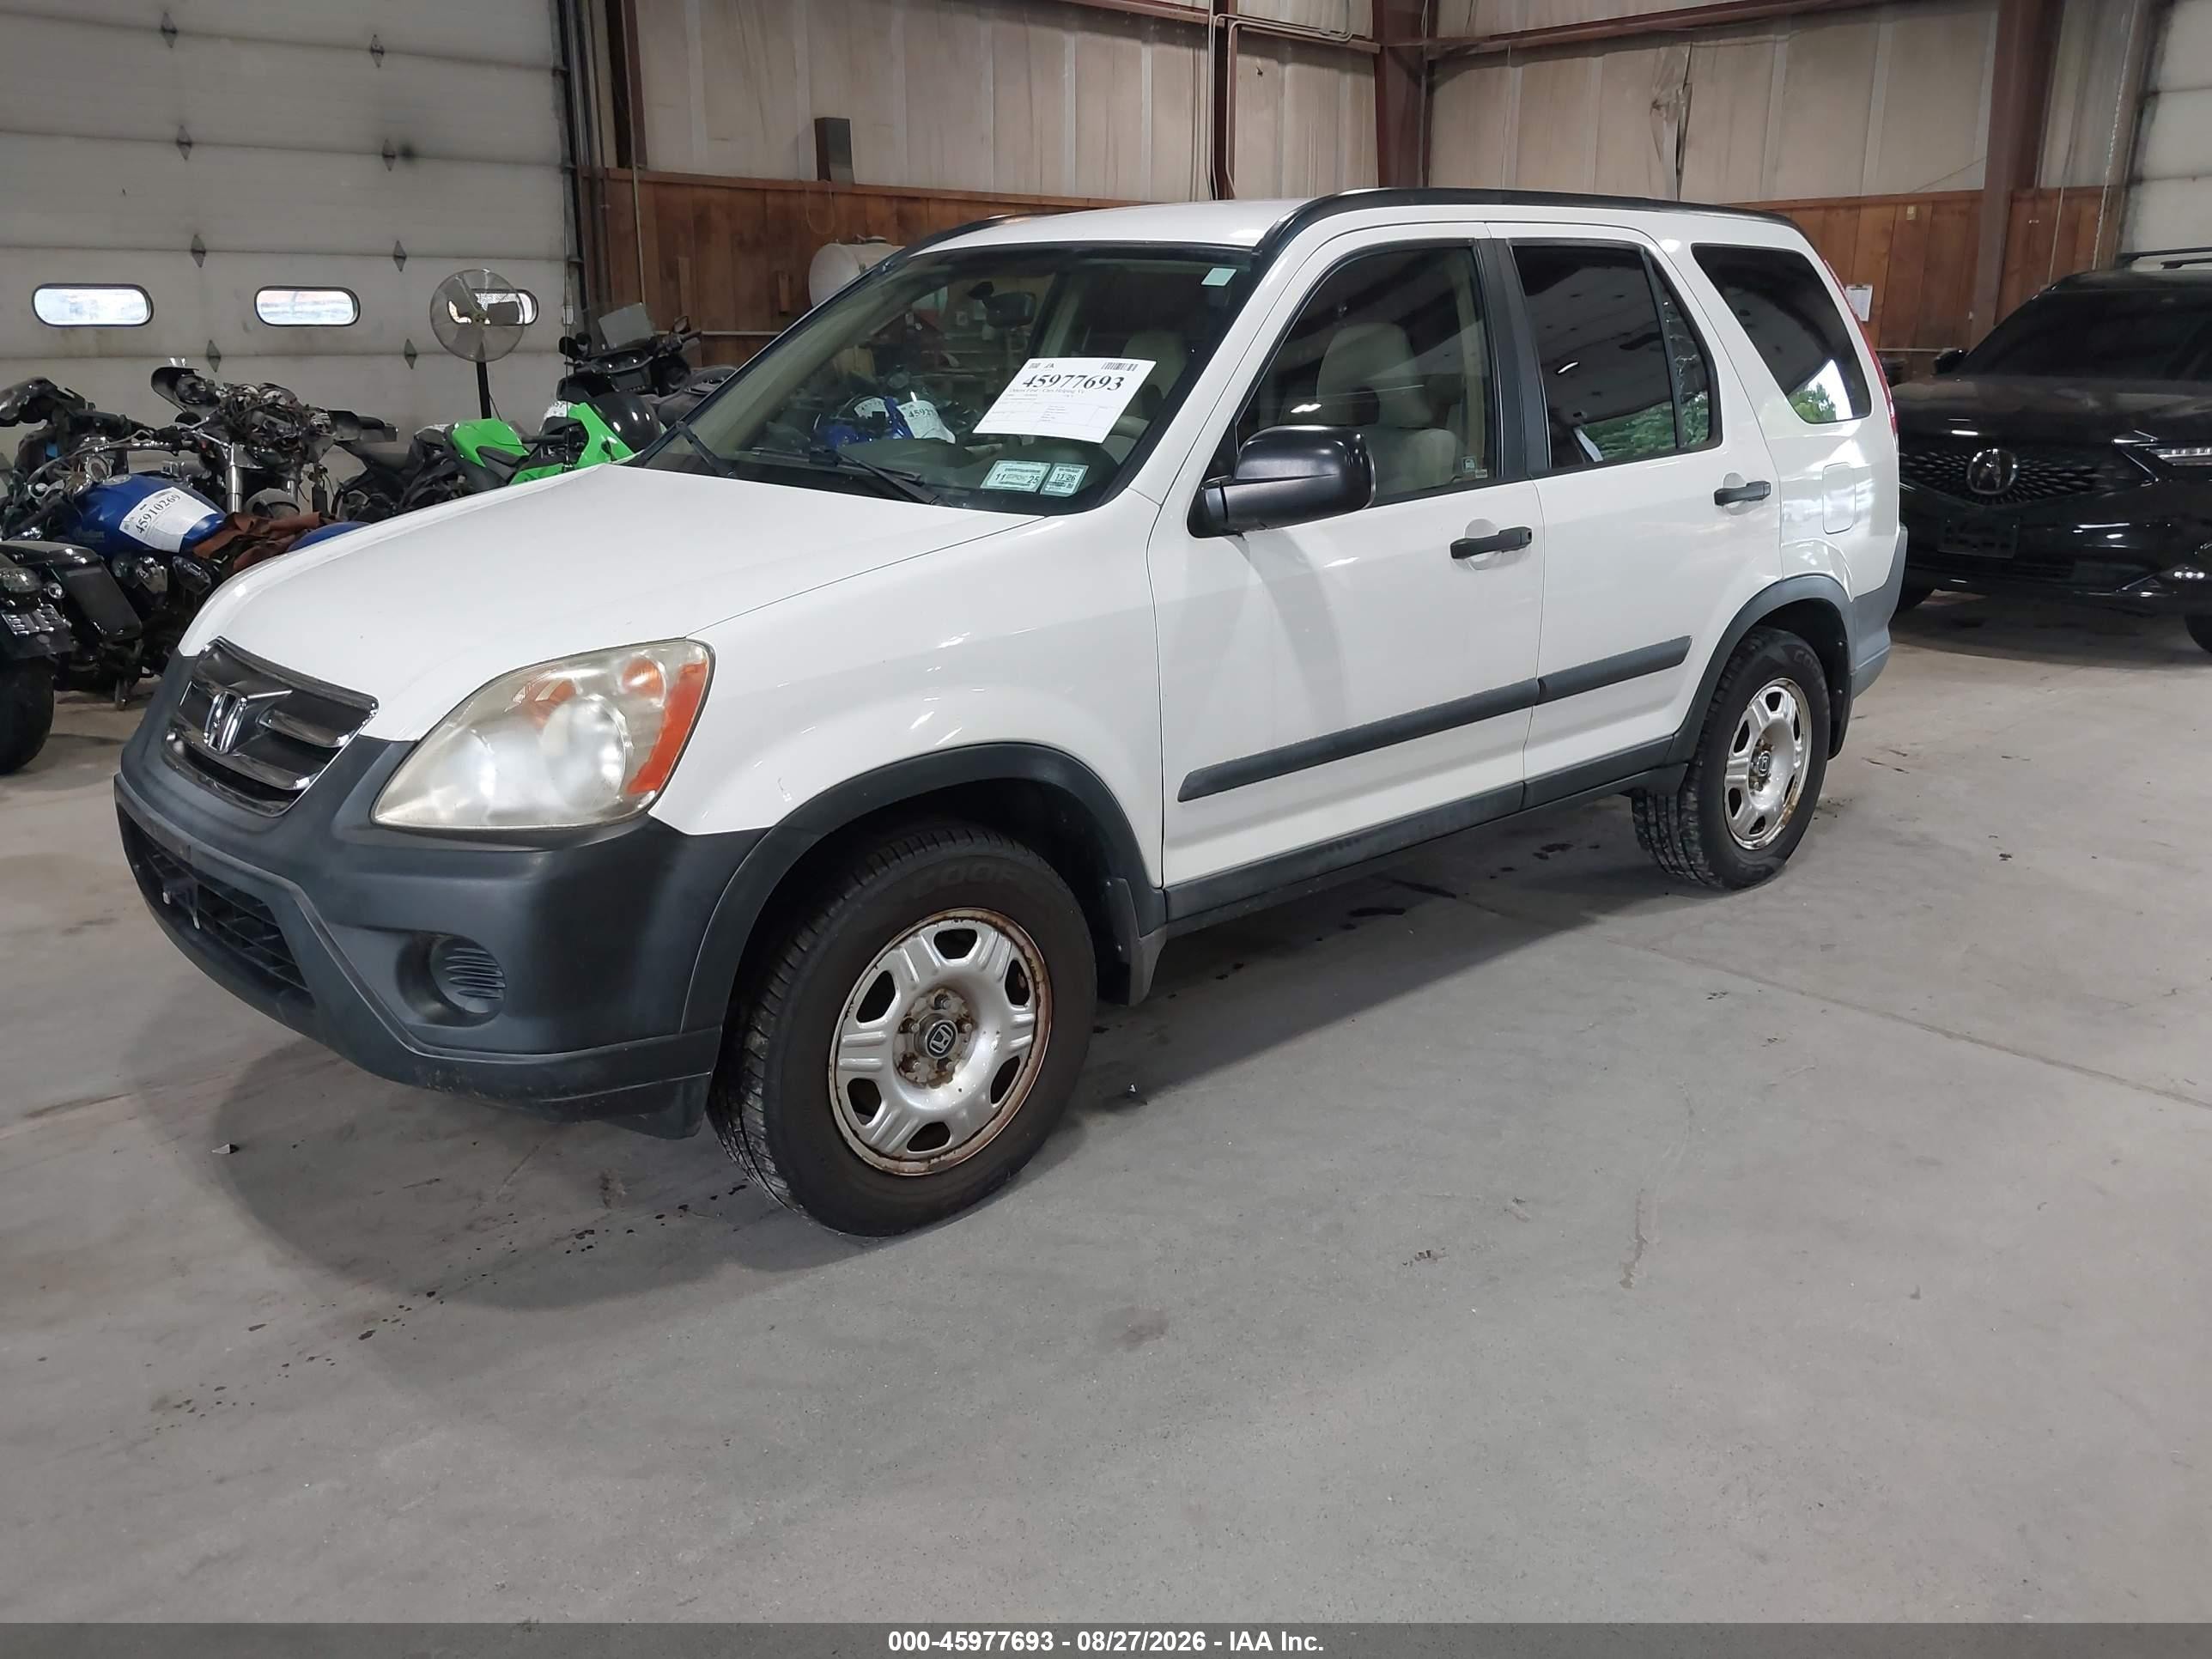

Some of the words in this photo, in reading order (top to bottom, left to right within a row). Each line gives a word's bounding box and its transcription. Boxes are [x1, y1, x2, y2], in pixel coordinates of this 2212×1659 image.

[1022, 374, 1125, 392] 45977693
[1027, 475, 1040, 484] 25
[135, 494, 181, 534] 45910269
